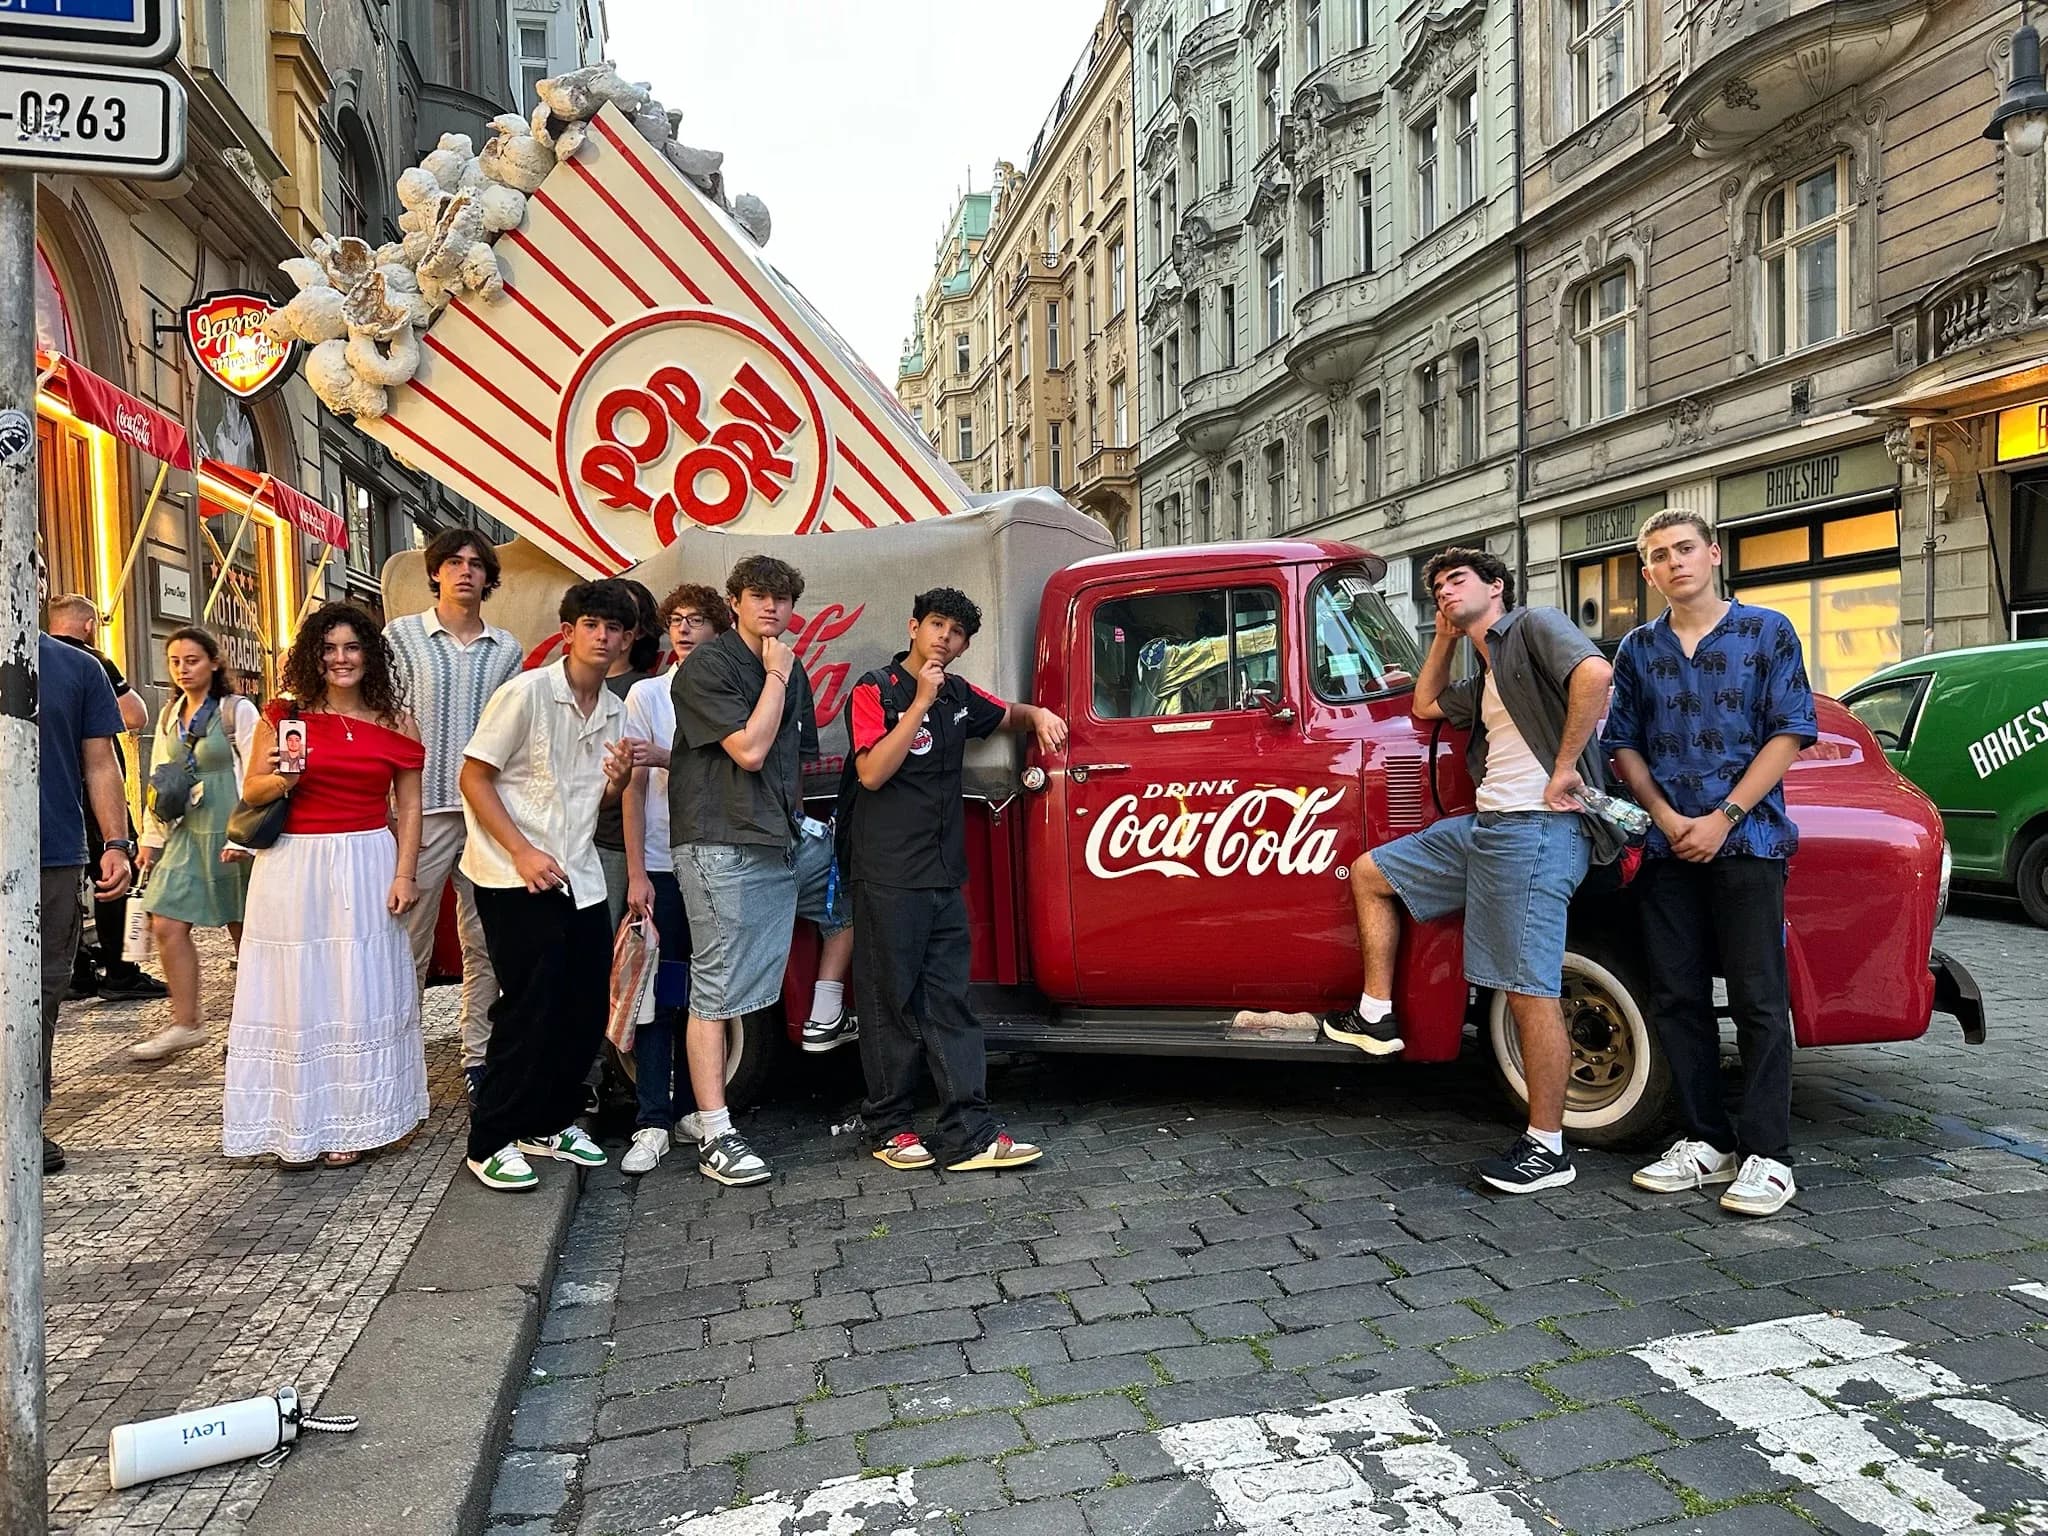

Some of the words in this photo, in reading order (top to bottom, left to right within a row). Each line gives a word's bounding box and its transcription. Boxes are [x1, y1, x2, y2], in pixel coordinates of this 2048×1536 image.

[581, 366, 711, 513] POP
[1766, 455, 1840, 508] BAKESHOP
[1586, 503, 1637, 546] BAKESHOP
[1142, 779, 1239, 799] DRINK
[1085, 785, 1347, 879] Coca-Cola
[182, 1420, 227, 1445] Levi
